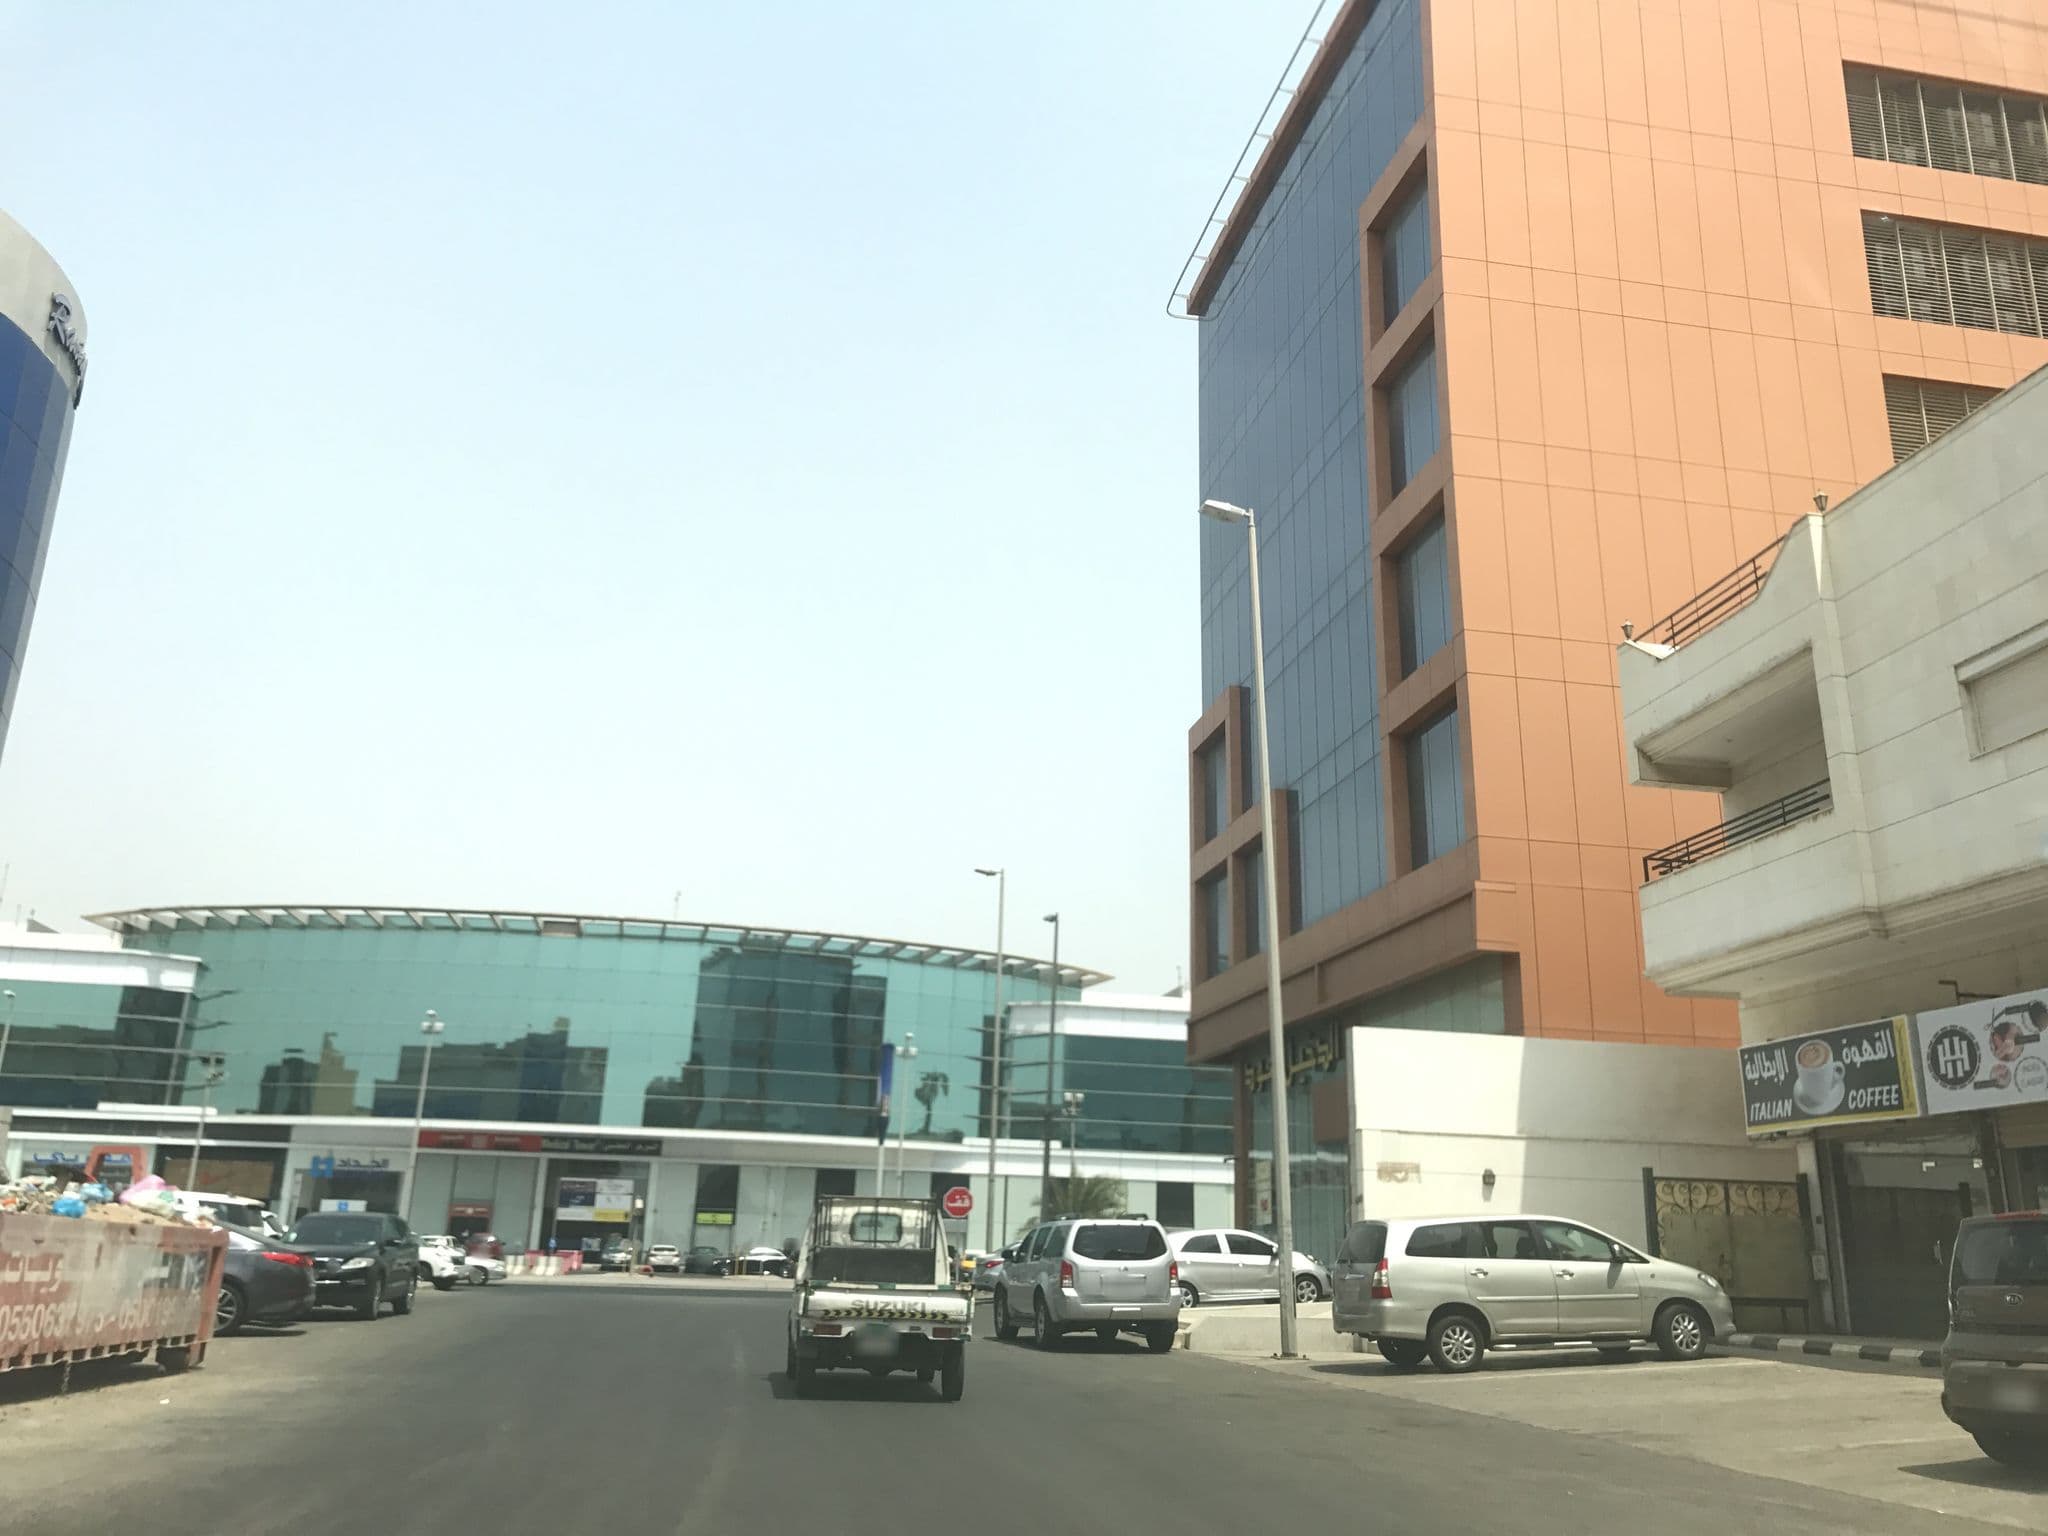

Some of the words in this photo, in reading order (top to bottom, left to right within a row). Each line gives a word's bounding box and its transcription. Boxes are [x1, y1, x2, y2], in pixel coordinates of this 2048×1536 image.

[1842, 1029, 1895, 1068] القهوة
[1750, 1099, 1793, 1122] ITALIAN
[1848, 1084, 1900, 1110] COFFEE
[851, 1299, 926, 1313] SUZUKI
